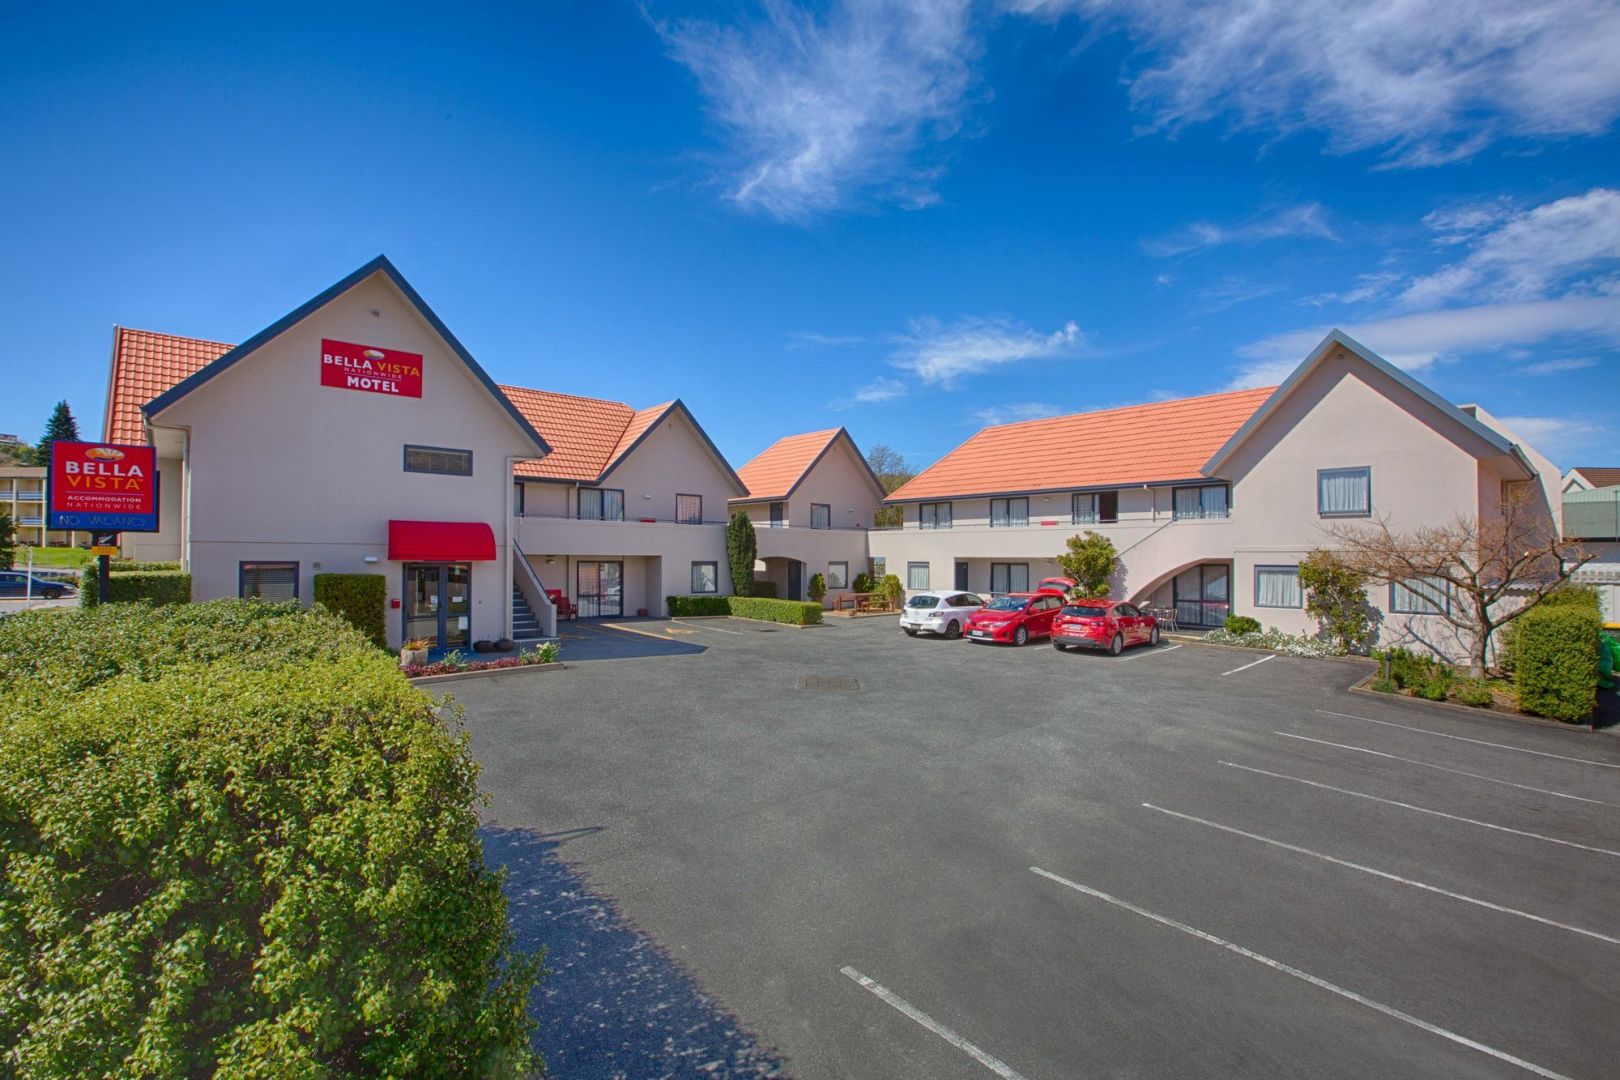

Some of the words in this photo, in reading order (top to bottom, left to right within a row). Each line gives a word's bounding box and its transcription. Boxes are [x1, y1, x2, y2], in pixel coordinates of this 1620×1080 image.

[323, 353, 373, 370] BELLA
[377, 361, 420, 377] VISTA
[344, 367, 402, 379] NATIONWIDE
[347, 375, 399, 393] MOTEL
[65, 461, 144, 477] BELLA
[66, 475, 141, 490] VISTA
[67, 495, 142, 503] ACCOMMODATION
[66, 502, 142, 510] NATIONWIDE
[59, 515, 80, 526] NO
[89, 516, 148, 527] VACANCY
